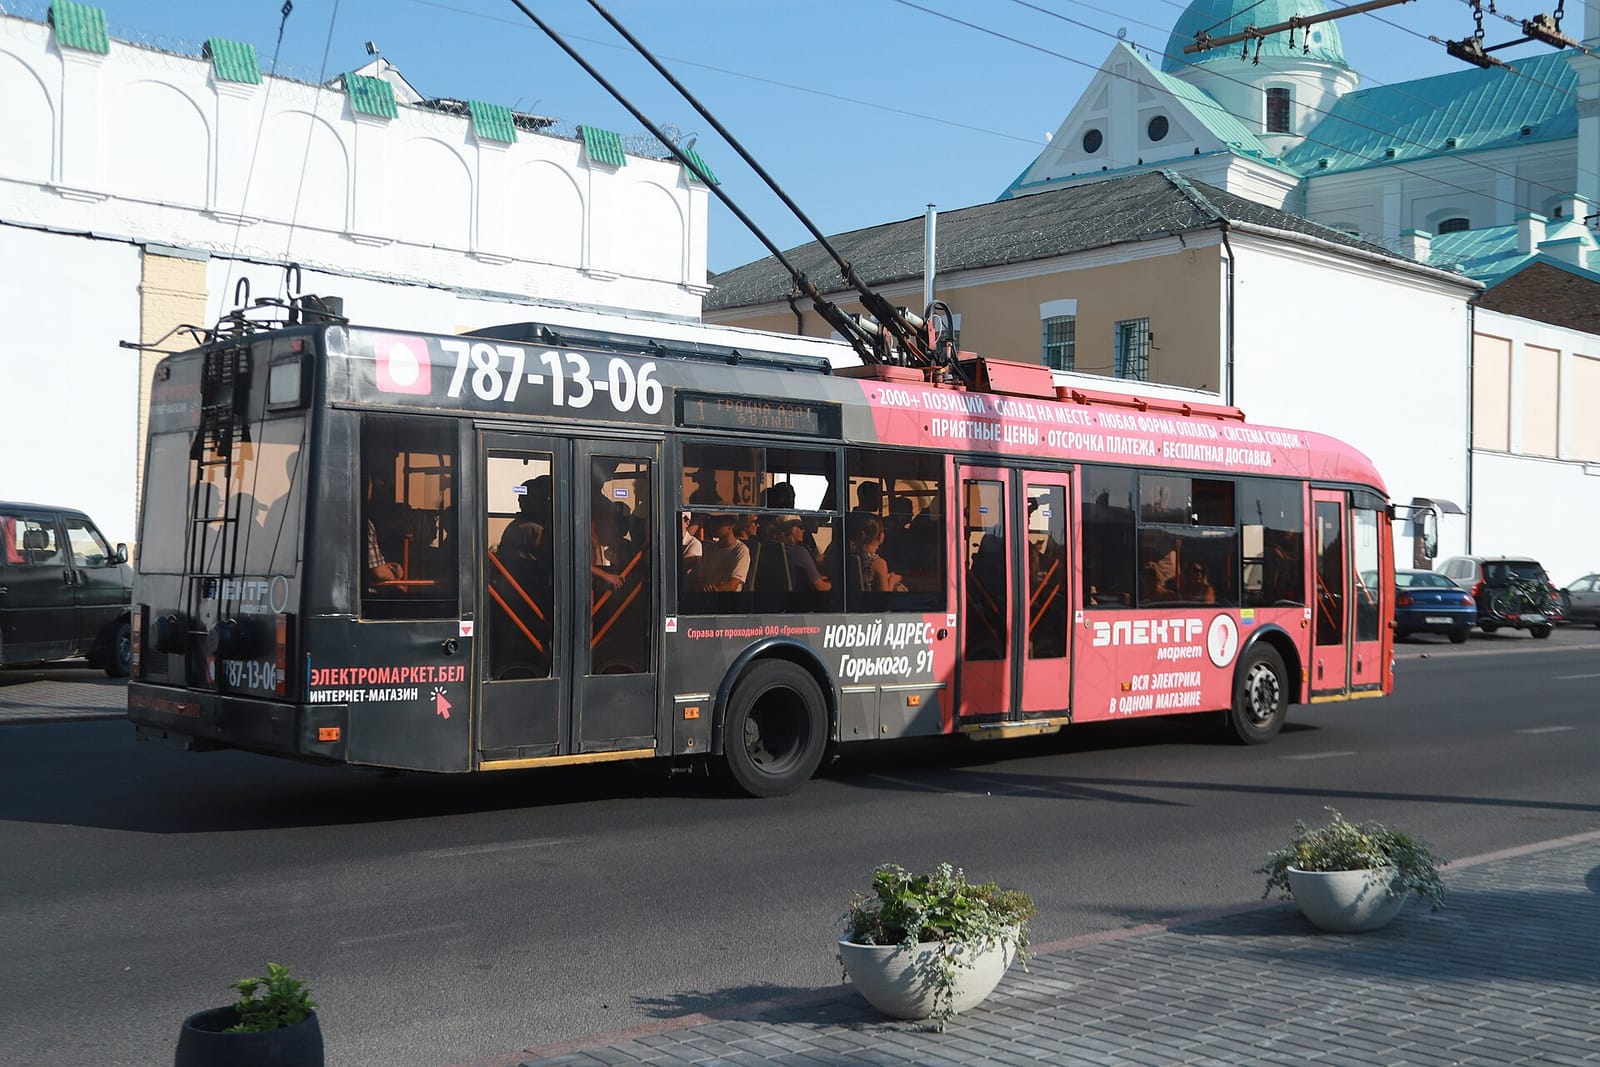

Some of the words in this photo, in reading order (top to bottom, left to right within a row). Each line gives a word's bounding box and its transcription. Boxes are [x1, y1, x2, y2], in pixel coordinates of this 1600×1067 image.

[440, 339, 664, 415] 787-13-06
[878, 387, 921, 409] 2000+
[922, 391, 987, 415] ПОЗИЦИЙ
[993, 399, 1037, 422] СКЛАД
[1038, 405, 1054, 421] НА
[1055, 408, 1092, 427] МЕСТЕ
[1099, 411, 1137, 431] ЛЮБАЯ
[1138, 416, 1176, 435] ФОРМА
[1176, 420, 1218, 439] ОПЛАТЫ
[1222, 425, 1266, 444] СИСТЕМА
[1264, 429, 1303, 449] СКИДОК
[931, 417, 1001, 442] ПРИЯТНЫЕ
[1003, 424, 1039, 447] ЦЕНЫ
[1047, 430, 1104, 452] ОТСРОЧКА
[1106, 435, 1156, 457] ПЛАТЕЖА
[1162, 441, 1226, 464] БЕСПЛАТНАЯ
[1225, 445, 1273, 468] ДОСТАВКА
[687, 627, 714, 640] Справа
[715, 629, 722, 638] от
[724, 625, 763, 639] проходной
[764, 625, 779, 636] ОАО
[823, 619, 882, 649] НОВЫЙ
[883, 621, 935, 649] АДРЕС:
[1157, 645, 1203, 662] маркет
[310, 665, 465, 687] ЭЛЕКТРОМАРКЕТ.БЕЛ
[838, 653, 912, 683] Горького,
[915, 649, 935, 673] 91
[1131, 674, 1149, 692] ВСЯ
[1151, 671, 1201, 688] ЭЛЕКТРИКА
[309, 687, 419, 704] ИНТЕРНЕТ-МАГАЗИН
[1109, 697, 1117, 714] В
[1119, 695, 1154, 714] ОДНОМ
[1155, 690, 1201, 710] МАГАЗИНЕ
